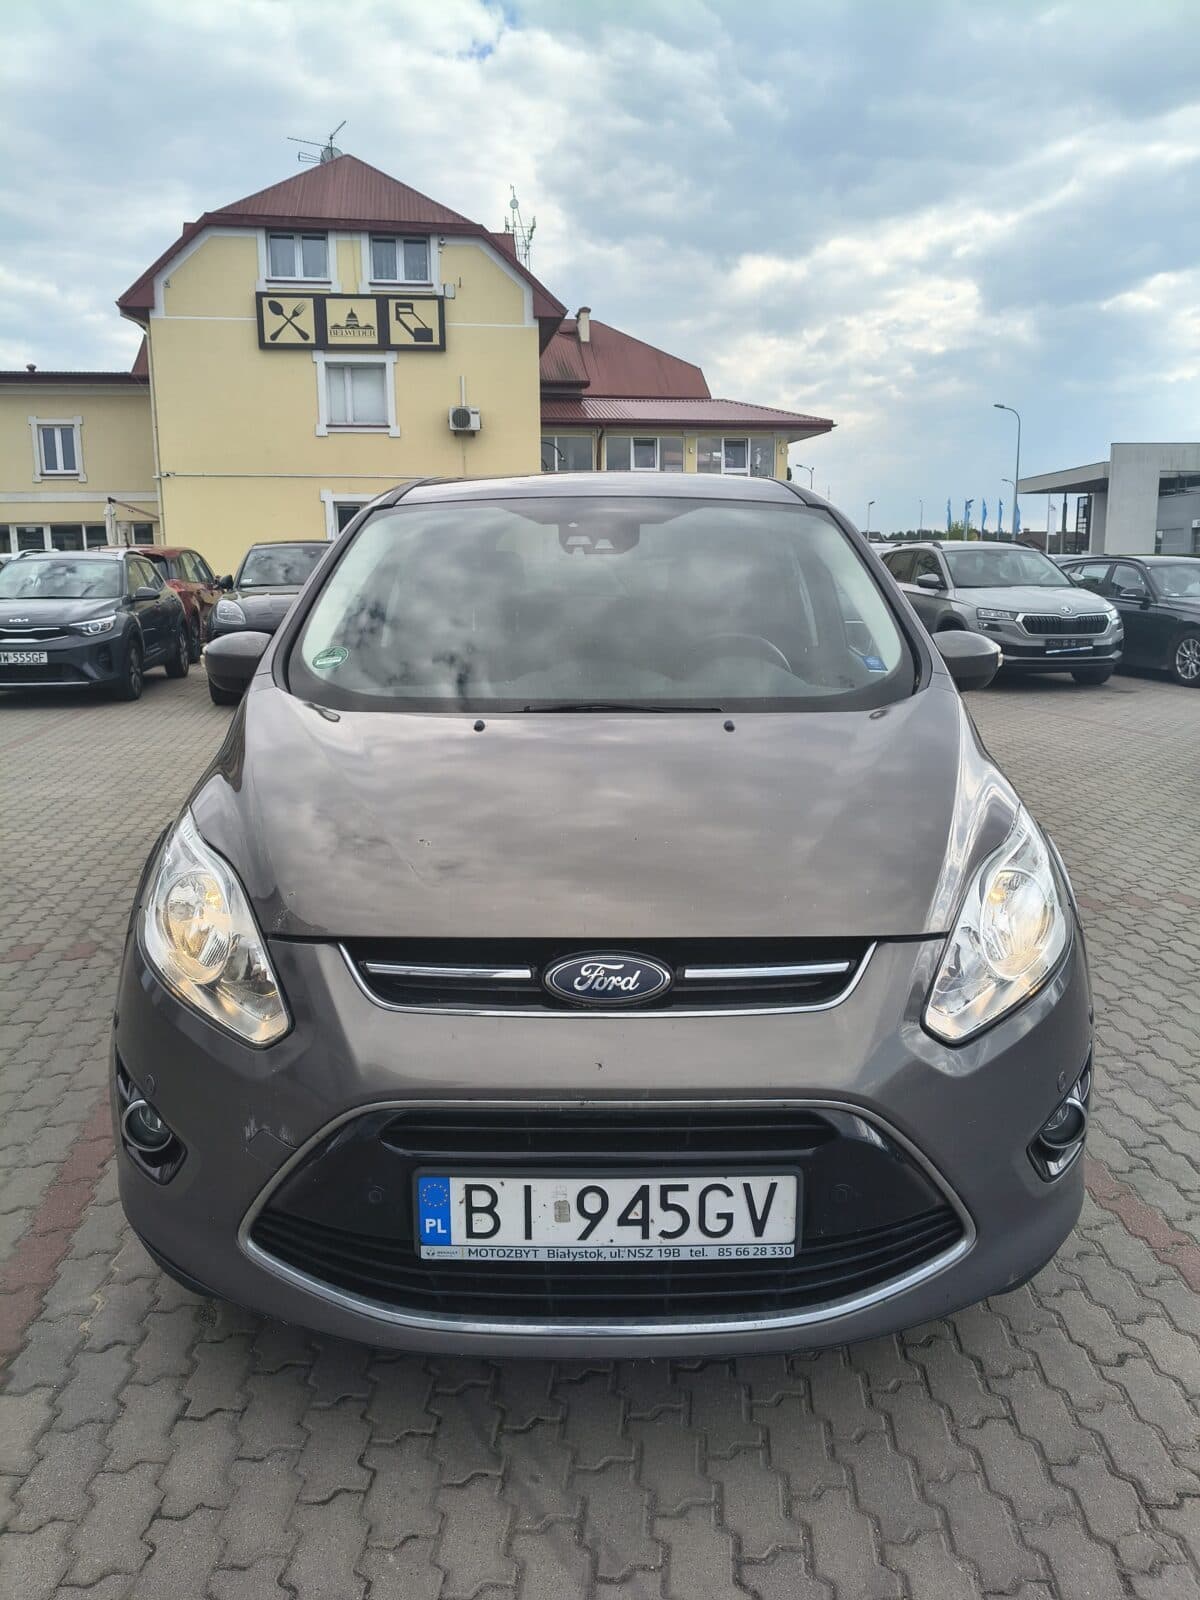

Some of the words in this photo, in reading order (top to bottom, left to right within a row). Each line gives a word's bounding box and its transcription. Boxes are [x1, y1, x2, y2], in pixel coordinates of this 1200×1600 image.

[573, 962, 641, 991] Ford
[465, 1183, 533, 1241] BI
[576, 1182, 778, 1242] 945GV
[425, 1218, 447, 1234] PL
[467, 1248, 540, 1259] MOTOZBYT
[547, 1248, 607, 1261] Białystok,
[609, 1249, 624, 1259] ul.
[627, 1248, 654, 1259] NSZ
[659, 1247, 681, 1258] 19B
[689, 1247, 708, 1258] tel.
[717, 1247, 732, 1257] 85
[736, 1247, 750, 1257] 66
[752, 1246, 767, 1257] 28
[770, 1246, 792, 1256] 330
